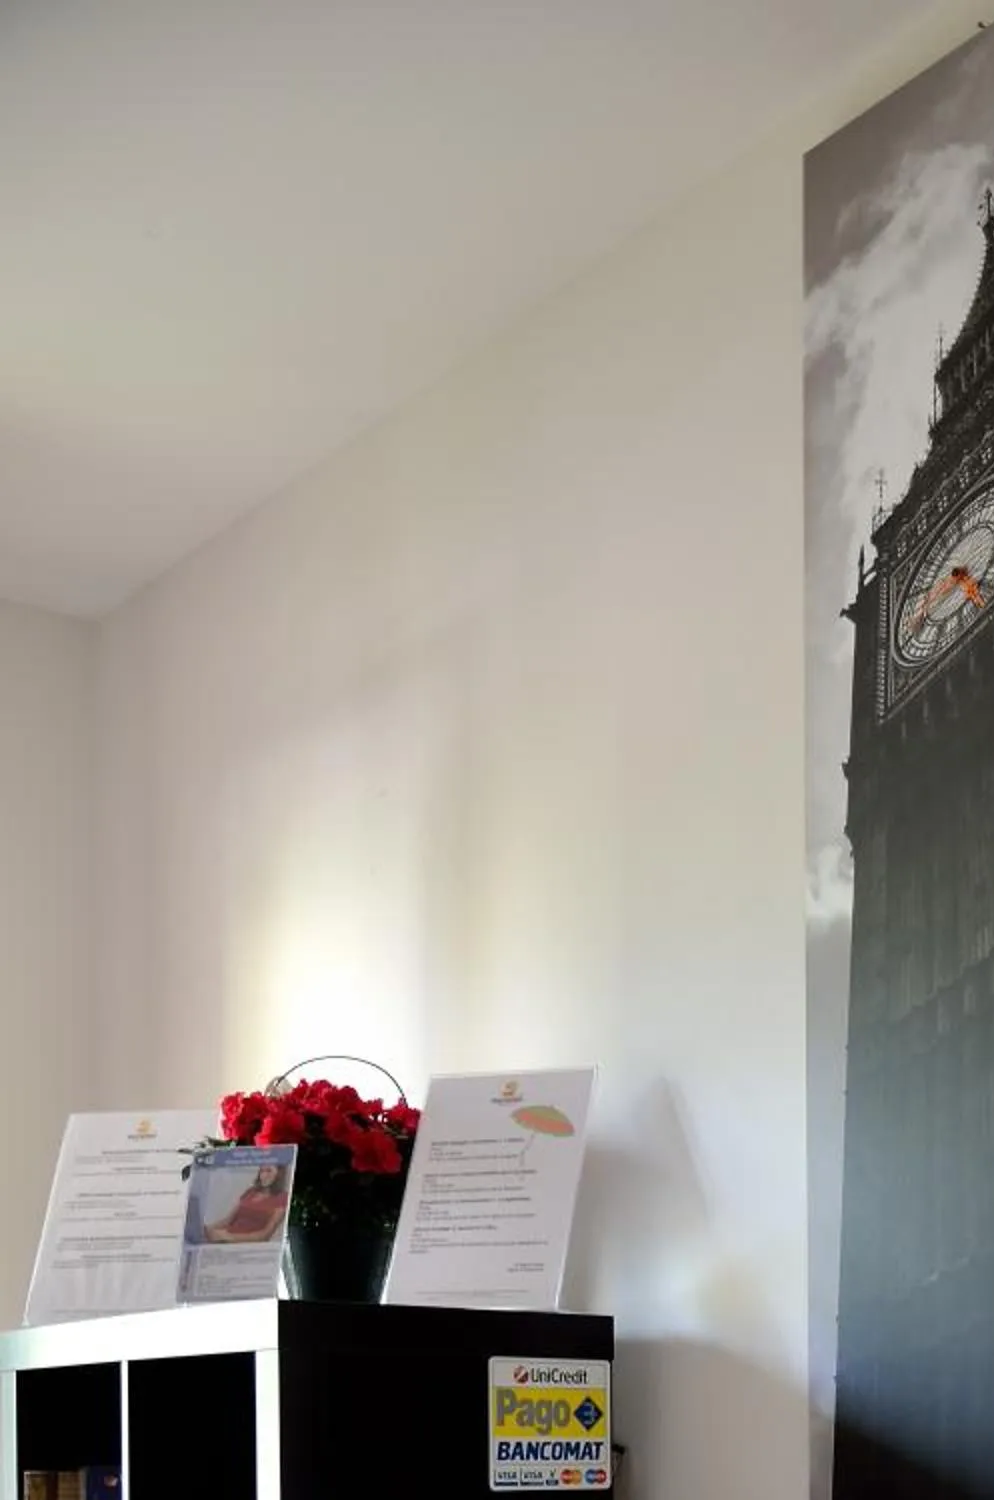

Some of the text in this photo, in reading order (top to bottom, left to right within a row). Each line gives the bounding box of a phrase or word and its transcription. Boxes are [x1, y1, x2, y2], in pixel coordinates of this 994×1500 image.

[531, 1367, 588, 1384] UniCredit
[496, 1388, 571, 1436] Pago
[497, 1441, 604, 1461] BANCOMAT
